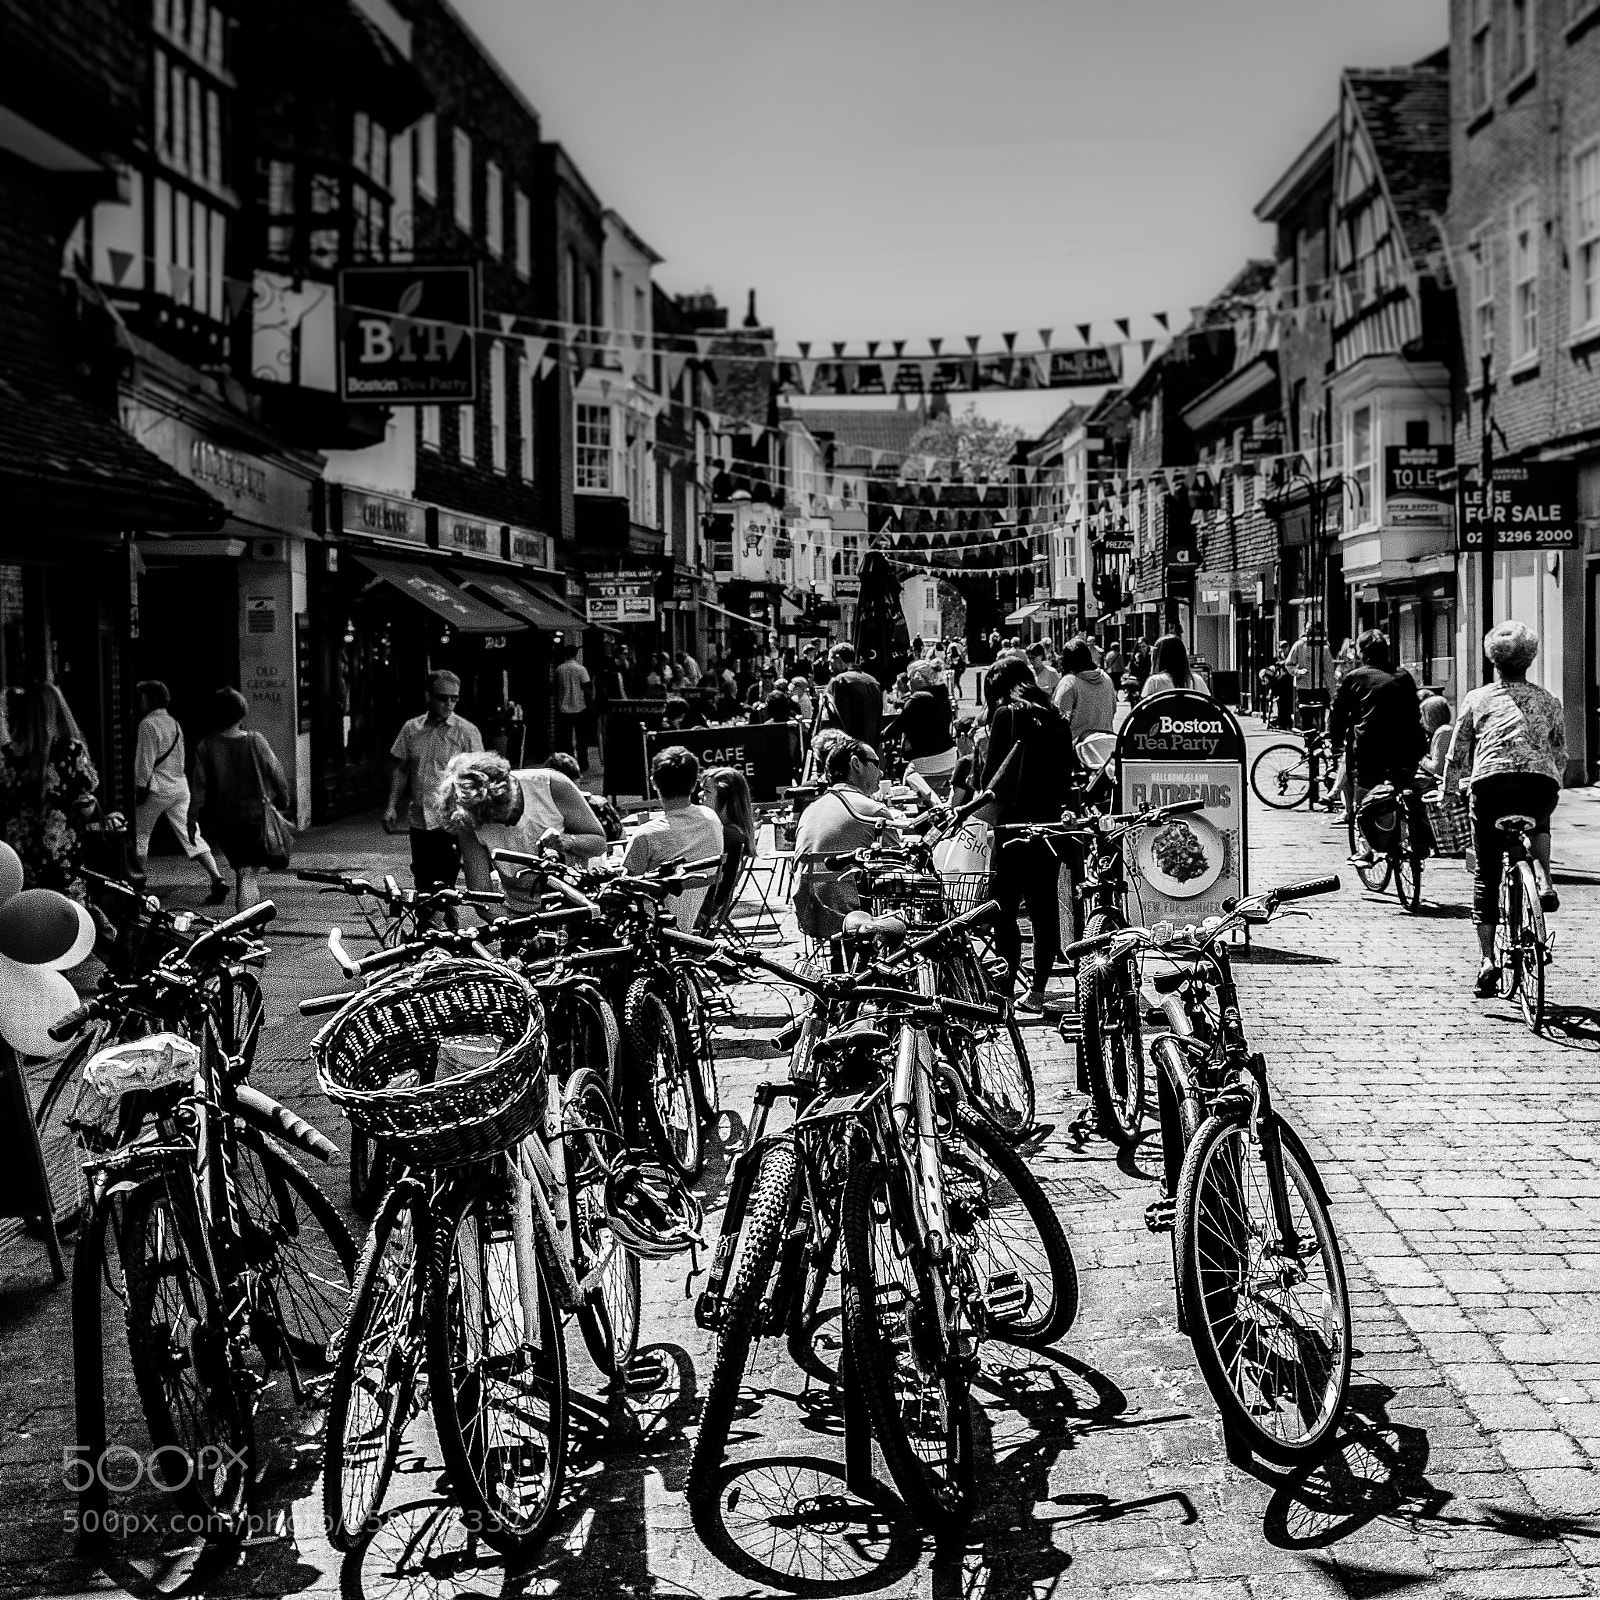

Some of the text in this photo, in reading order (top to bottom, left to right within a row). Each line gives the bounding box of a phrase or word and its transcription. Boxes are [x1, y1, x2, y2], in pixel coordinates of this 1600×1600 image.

[348, 377, 398, 392] Boston
[430, 377, 467, 392] Party
[1392, 468, 1438, 485] TO LE
[1464, 490, 1512, 505] LESE
[1511, 504, 1562, 522] SALE
[1498, 530, 1532, 542] 3296
[1536, 529, 1573, 541] 2000
[600, 586, 640, 596] TO LET
[1159, 716, 1224, 734] Boston
[1133, 733, 1219, 754] Tea Party
